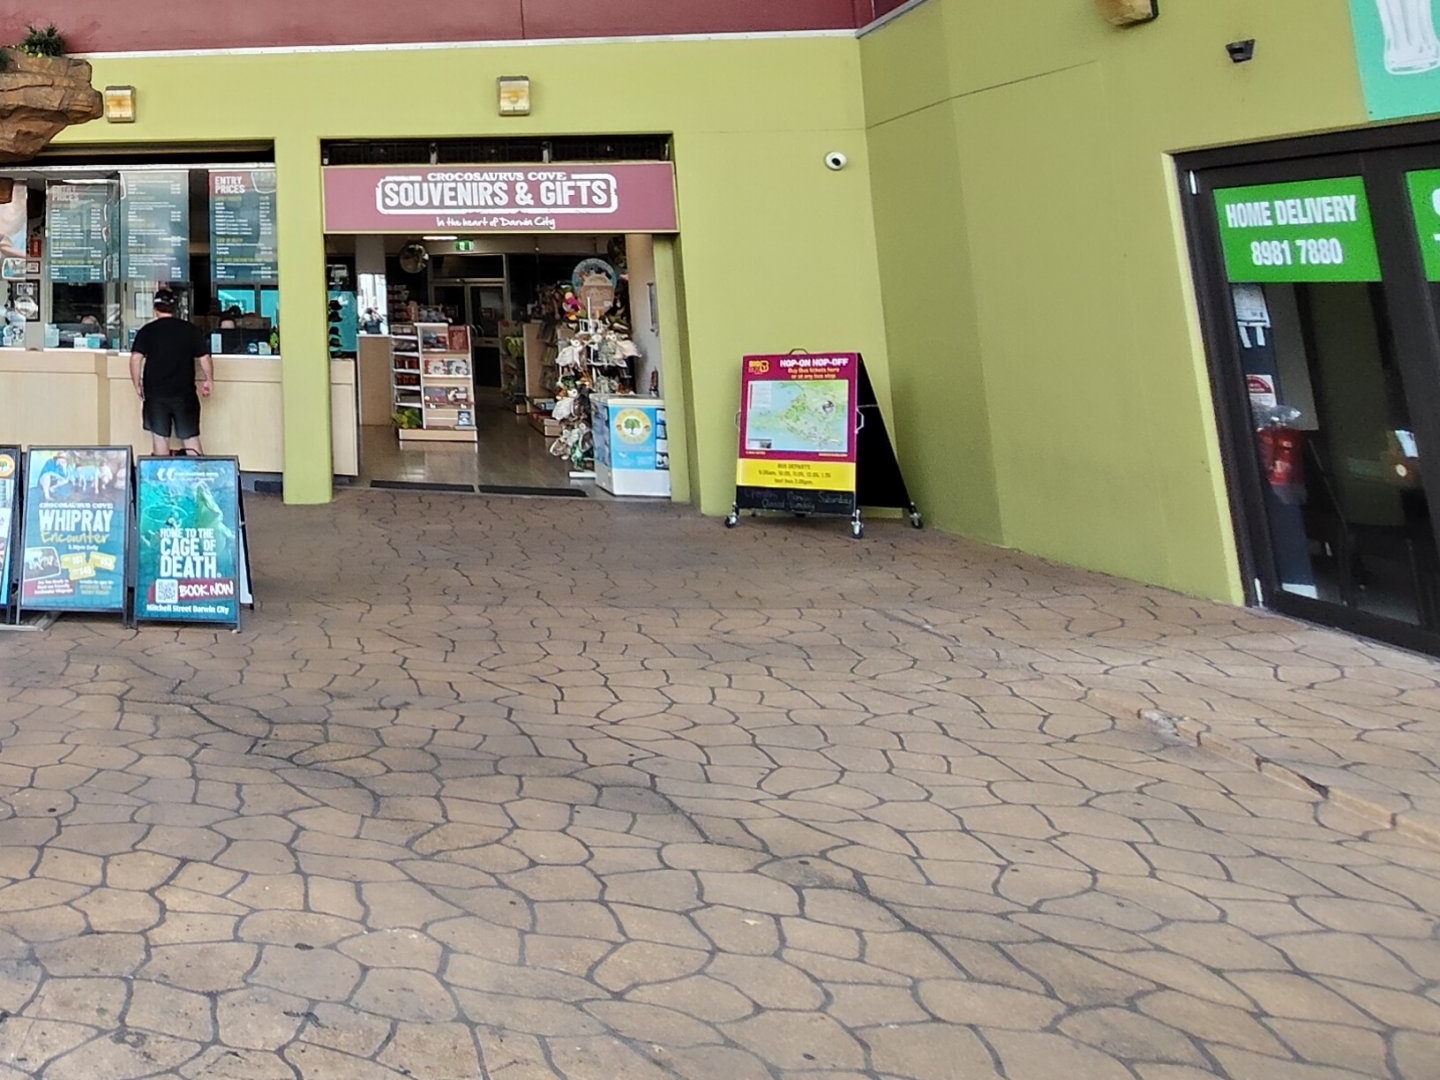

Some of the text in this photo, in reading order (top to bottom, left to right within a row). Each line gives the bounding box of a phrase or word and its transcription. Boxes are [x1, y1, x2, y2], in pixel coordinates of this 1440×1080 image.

[215, 176, 242, 185] ENTRY
[427, 171, 567, 181] CROCOSAURUS COVE
[215, 185, 246, 194] PRICES
[384, 181, 608, 207] SOUVENIRS & GIFTS
[1225, 195, 1357, 228] HOME DELIVERY
[445, 217, 459, 227] the
[459, 217, 487, 227] heart
[489, 217, 499, 228] of
[501, 217, 533, 227] Darwin
[534, 217, 556, 229] City
[1250, 238, 1344, 266] 8981 7880
[780, 358, 849, 367] HOP-ON HOP-OFF
[38, 509, 114, 532] WHIPRAY
[40, 530, 110, 544] Encounter
[160, 528, 214, 539] HOME TO THE
[160, 538, 217, 556] CAGE OF
[178, 580, 234, 597] BOOK NOW
[146, 603, 229, 615] Mitchell Street Darwin City
